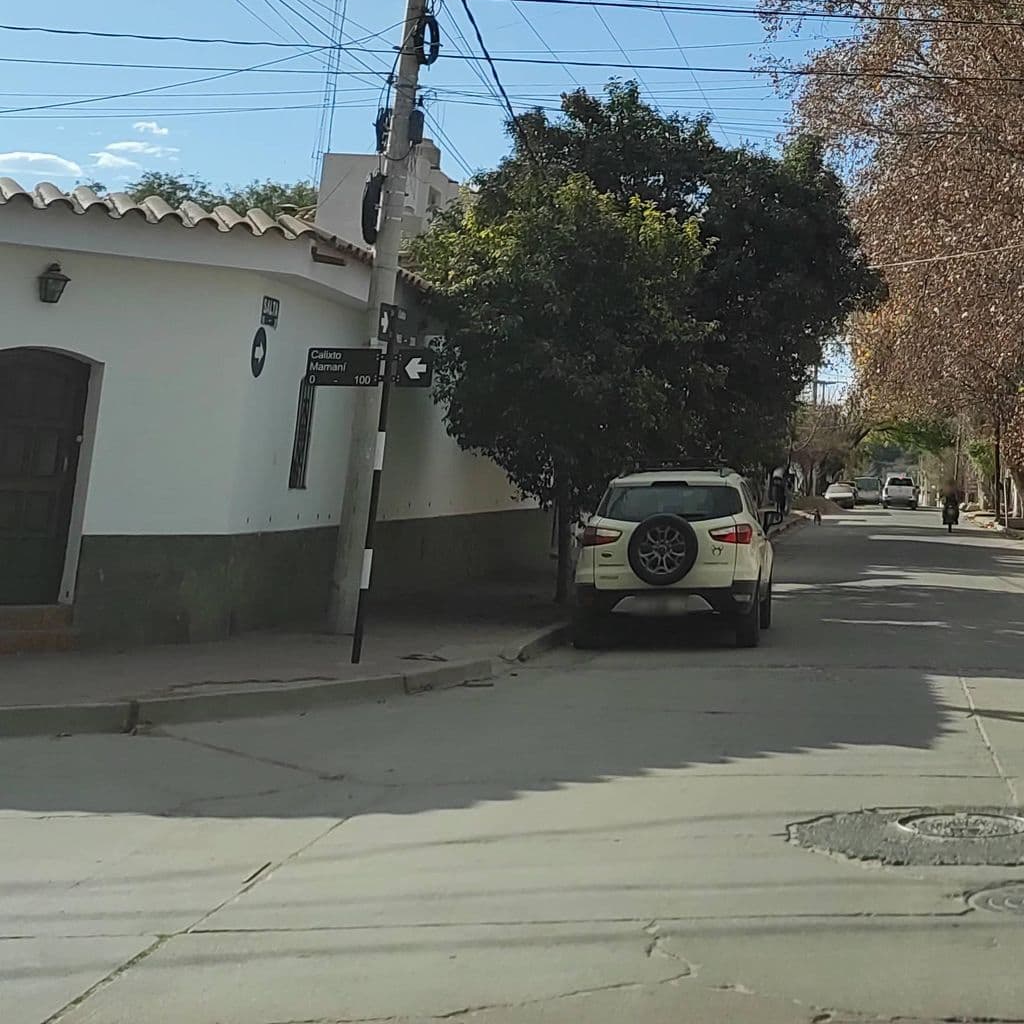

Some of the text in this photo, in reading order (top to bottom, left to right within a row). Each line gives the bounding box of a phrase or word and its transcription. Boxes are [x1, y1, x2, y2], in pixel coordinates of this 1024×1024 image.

[311, 350, 342, 360] Calixto
[309, 362, 347, 372] Mamaní
[309, 375, 316, 384] 0
[354, 375, 371, 384] 100
